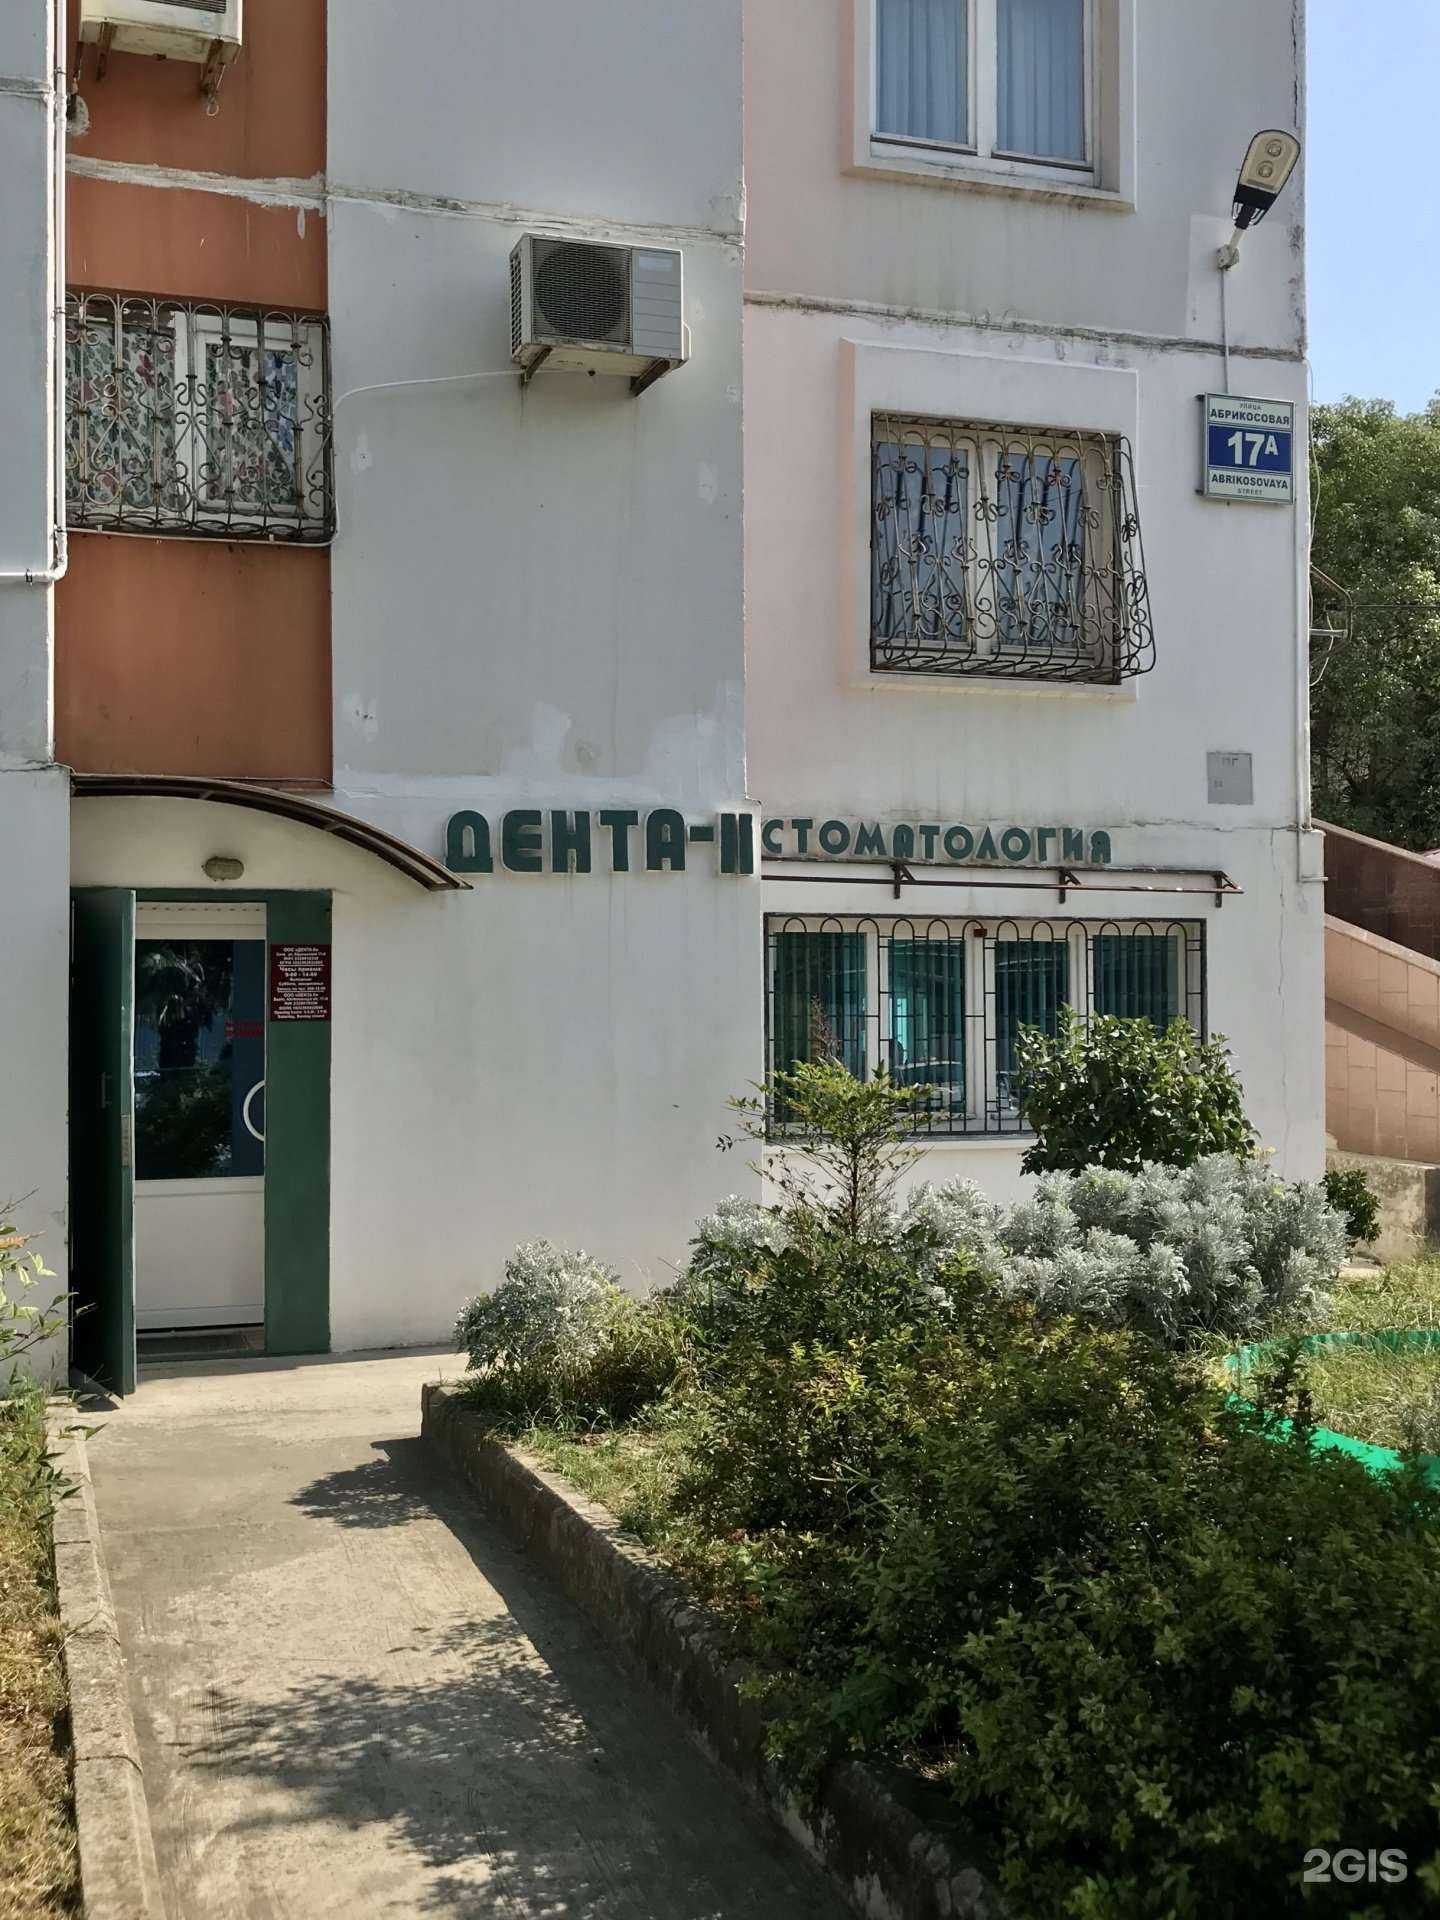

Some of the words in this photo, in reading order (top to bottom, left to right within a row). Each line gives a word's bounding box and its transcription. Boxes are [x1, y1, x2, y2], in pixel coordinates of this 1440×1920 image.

[1210, 409, 1290, 425] АБРИКОСОВАЯ
[1211, 474, 1288, 489] ABRIKOSOVAYA
[1237, 488, 1262, 496] STREET
[761, 818, 1112, 864] СТОМАТОЛОГИЯ
